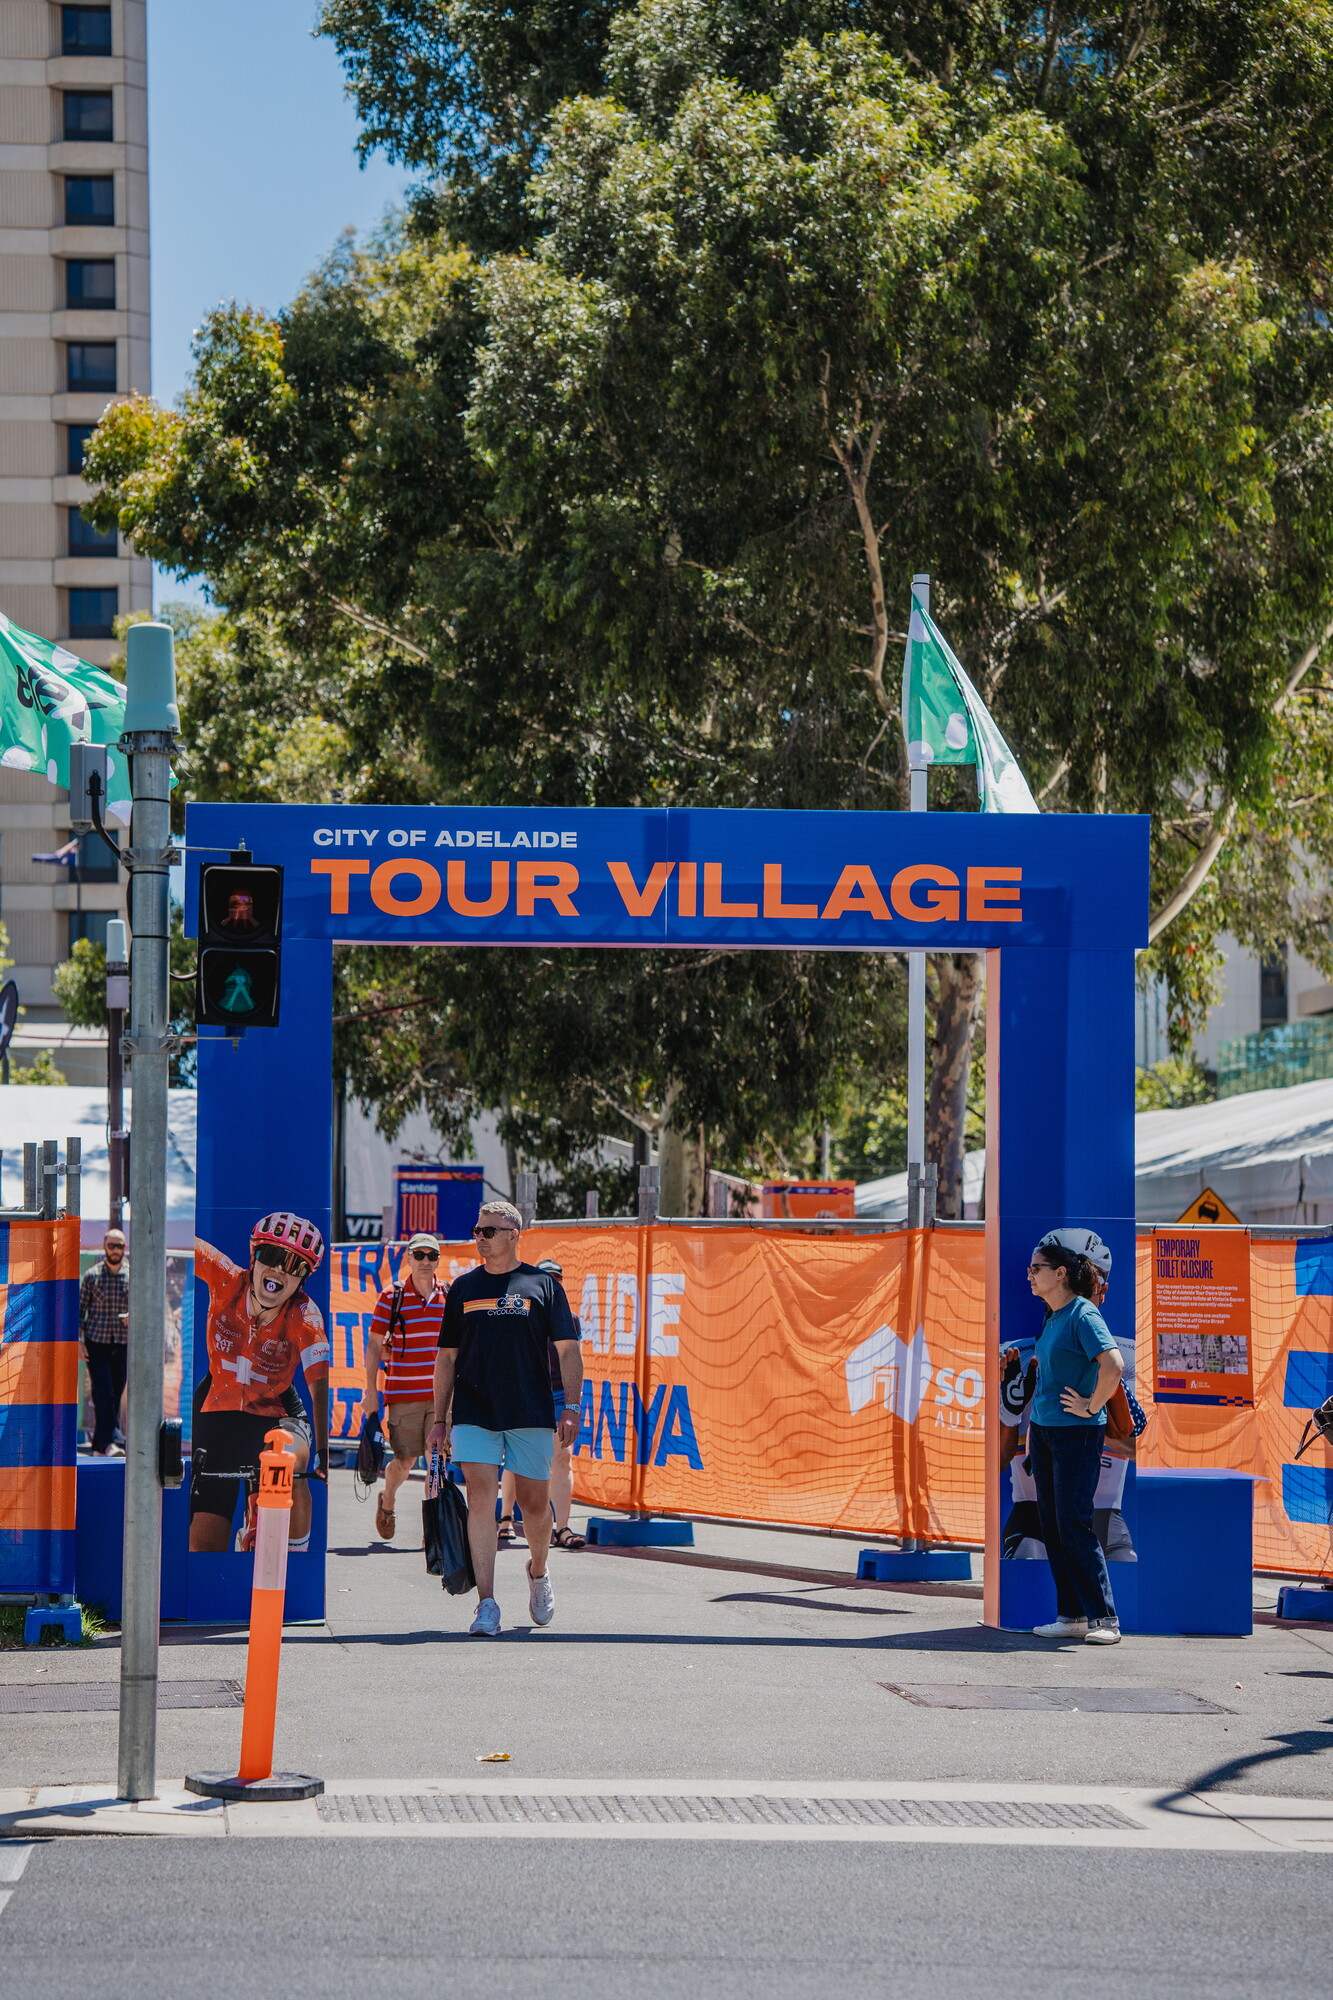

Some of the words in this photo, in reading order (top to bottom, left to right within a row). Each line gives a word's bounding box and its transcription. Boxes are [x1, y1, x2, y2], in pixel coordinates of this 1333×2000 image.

[313, 828, 379, 846] CITY
[387, 830, 426, 847] OF
[434, 830, 578, 848] ADELAIDE
[311, 858, 581, 917] TOUR
[606, 861, 1023, 922] VILLAGE
[401, 1182, 438, 1193] Santos
[402, 1193, 438, 1232] TOUR
[1156, 1239, 1200, 1258] TEMPORARY
[1156, 1259, 1179, 1278] TOILET
[1180, 1260, 1214, 1279] CLOSURE
[487, 1309, 530, 1317] CYCOLOGIST
[572, 1379, 705, 1470] ANYA
